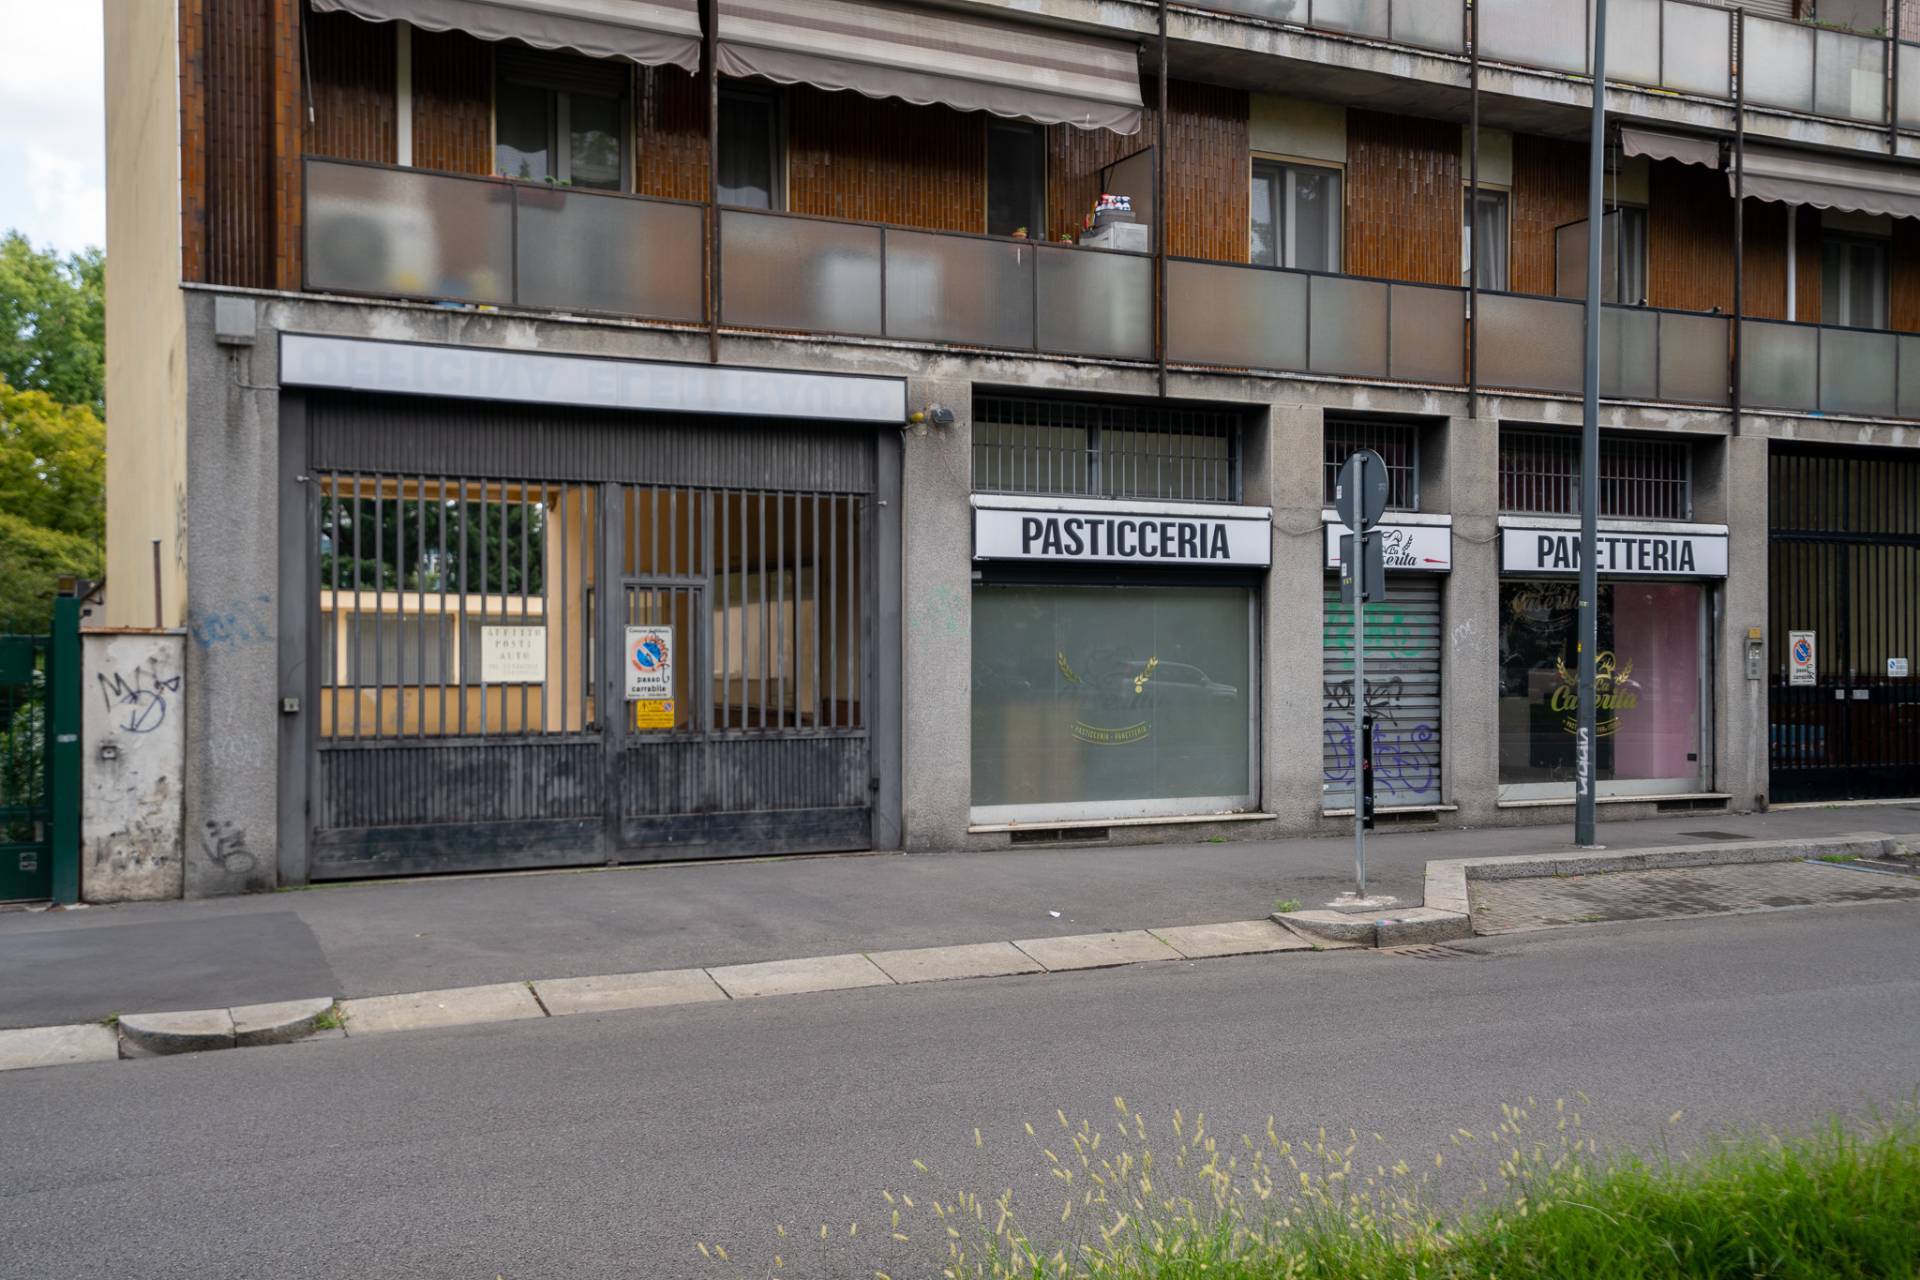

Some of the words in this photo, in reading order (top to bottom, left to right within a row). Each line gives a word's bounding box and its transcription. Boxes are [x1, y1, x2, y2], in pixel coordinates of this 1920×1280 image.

[1022, 516, 1231, 559] PASTICCERIA
[1537, 534, 1696, 572] PANETTERIA
[495, 639, 531, 649] POSTI
[632, 684, 667, 693] carrabile
